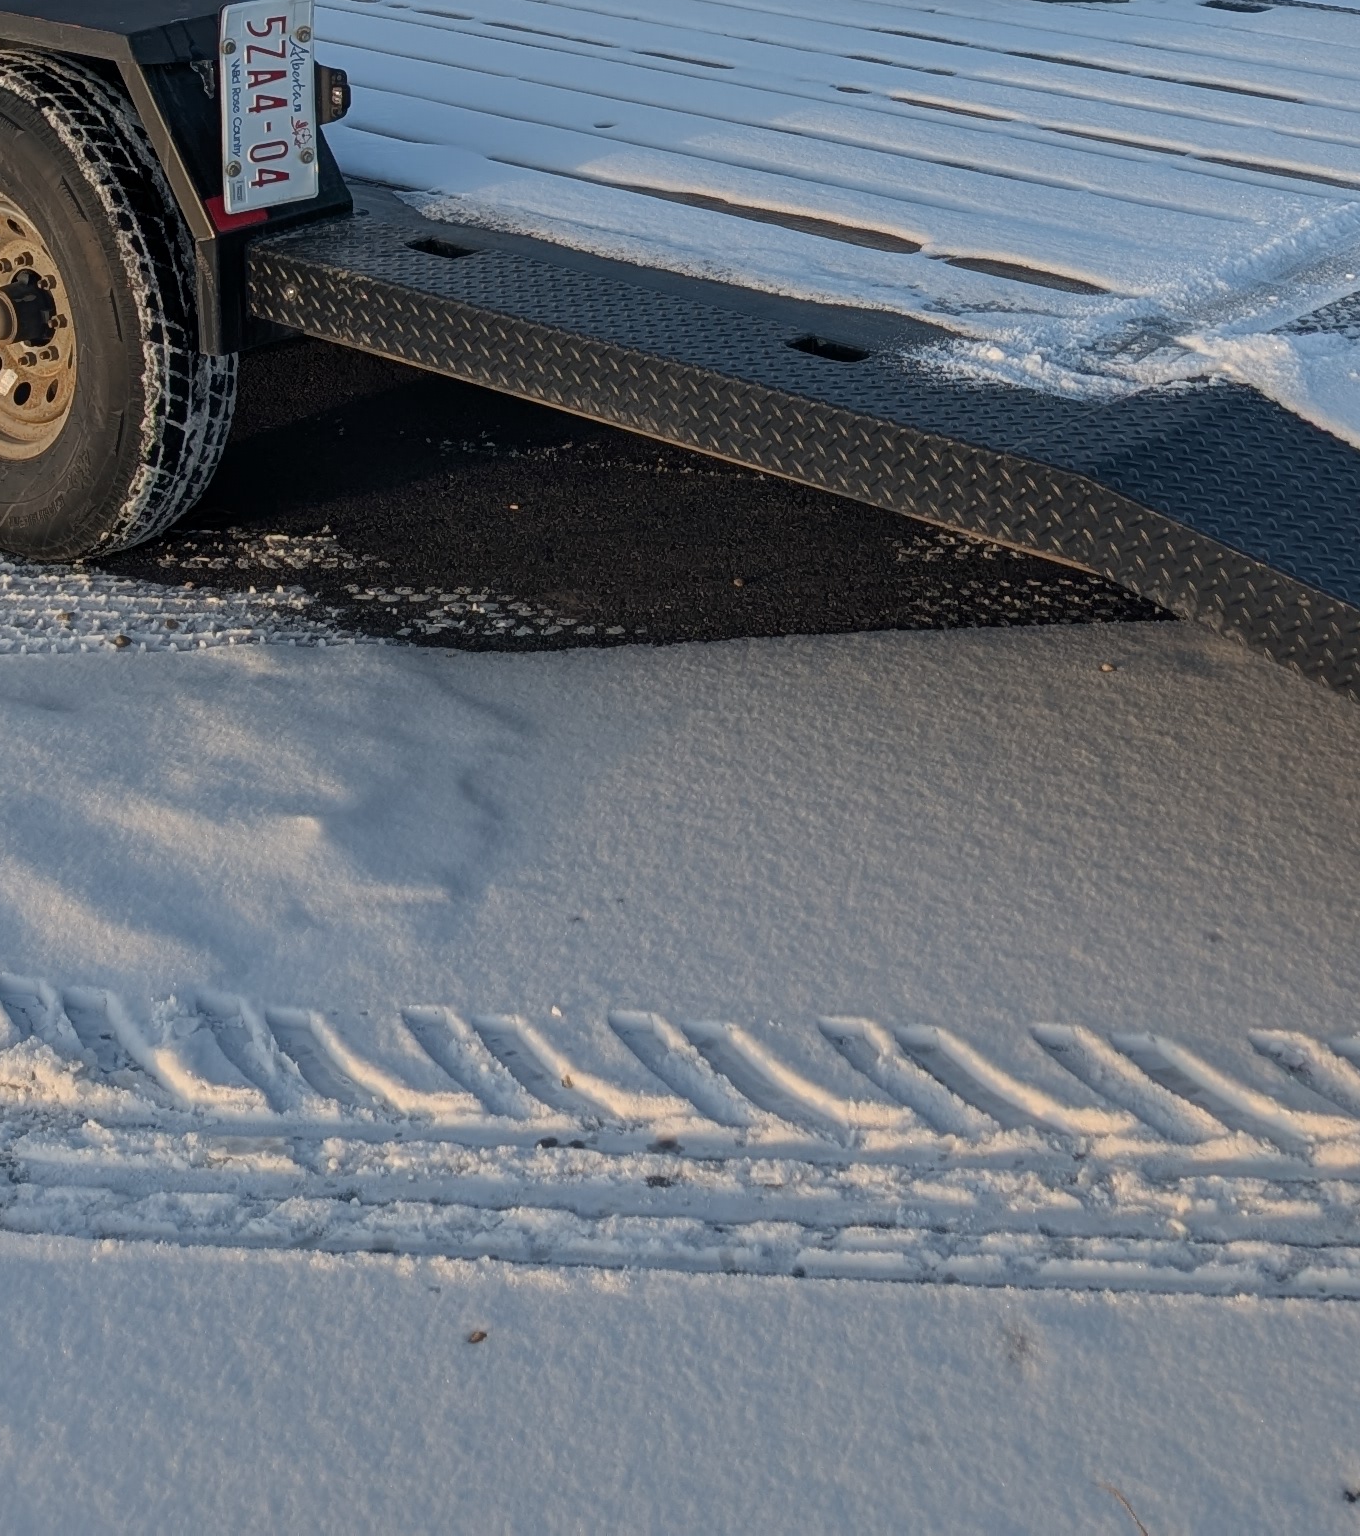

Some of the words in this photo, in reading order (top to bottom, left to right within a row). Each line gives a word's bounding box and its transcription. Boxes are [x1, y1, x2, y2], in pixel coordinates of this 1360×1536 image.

[231, 87, 242, 114] Rose
[246, 16, 290, 188] 5ZA4-04
[231, 117, 243, 158] Country
